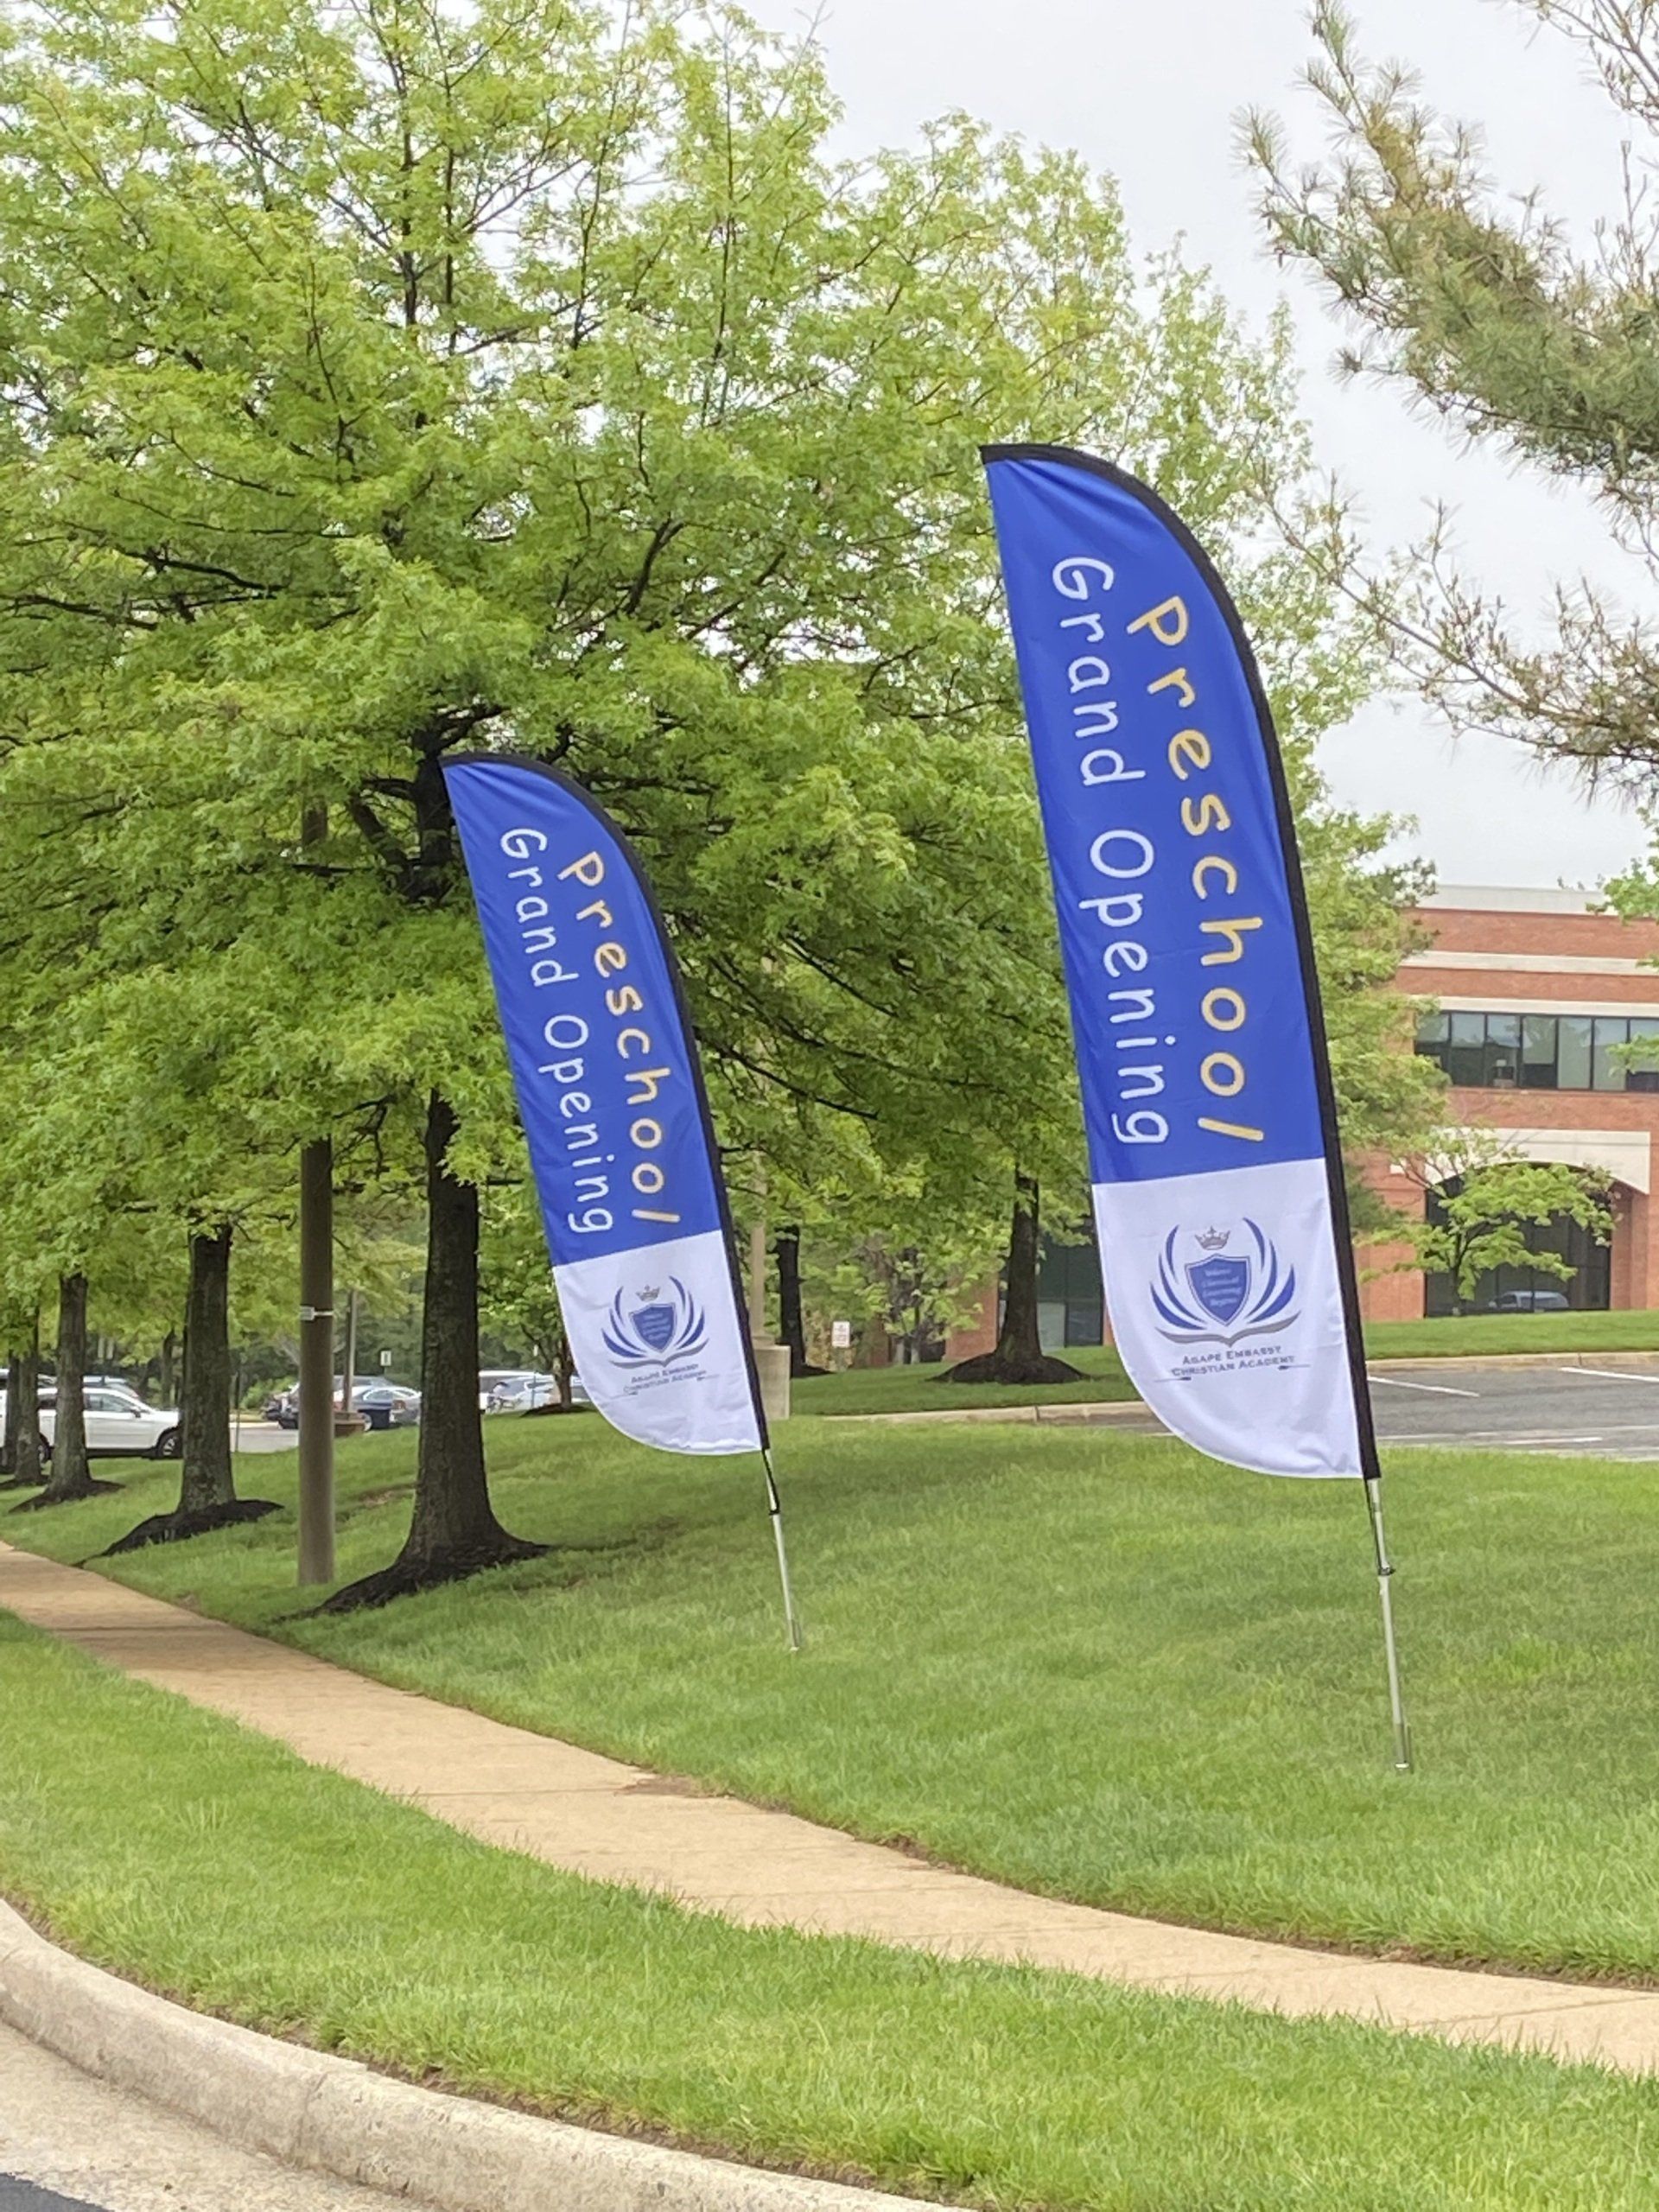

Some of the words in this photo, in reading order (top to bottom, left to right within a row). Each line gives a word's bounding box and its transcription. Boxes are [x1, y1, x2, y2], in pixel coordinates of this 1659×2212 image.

[1052, 557, 1147, 786] Grand
[499, 828, 580, 987] Grand
[1126, 595, 1265, 1142] Preschool
[557, 851, 681, 1223] Preschool
[1079, 830, 1174, 1144] Opening
[538, 1014, 614, 1233] Opening
[1172, 1363, 1235, 1376] CHRISTIAN
